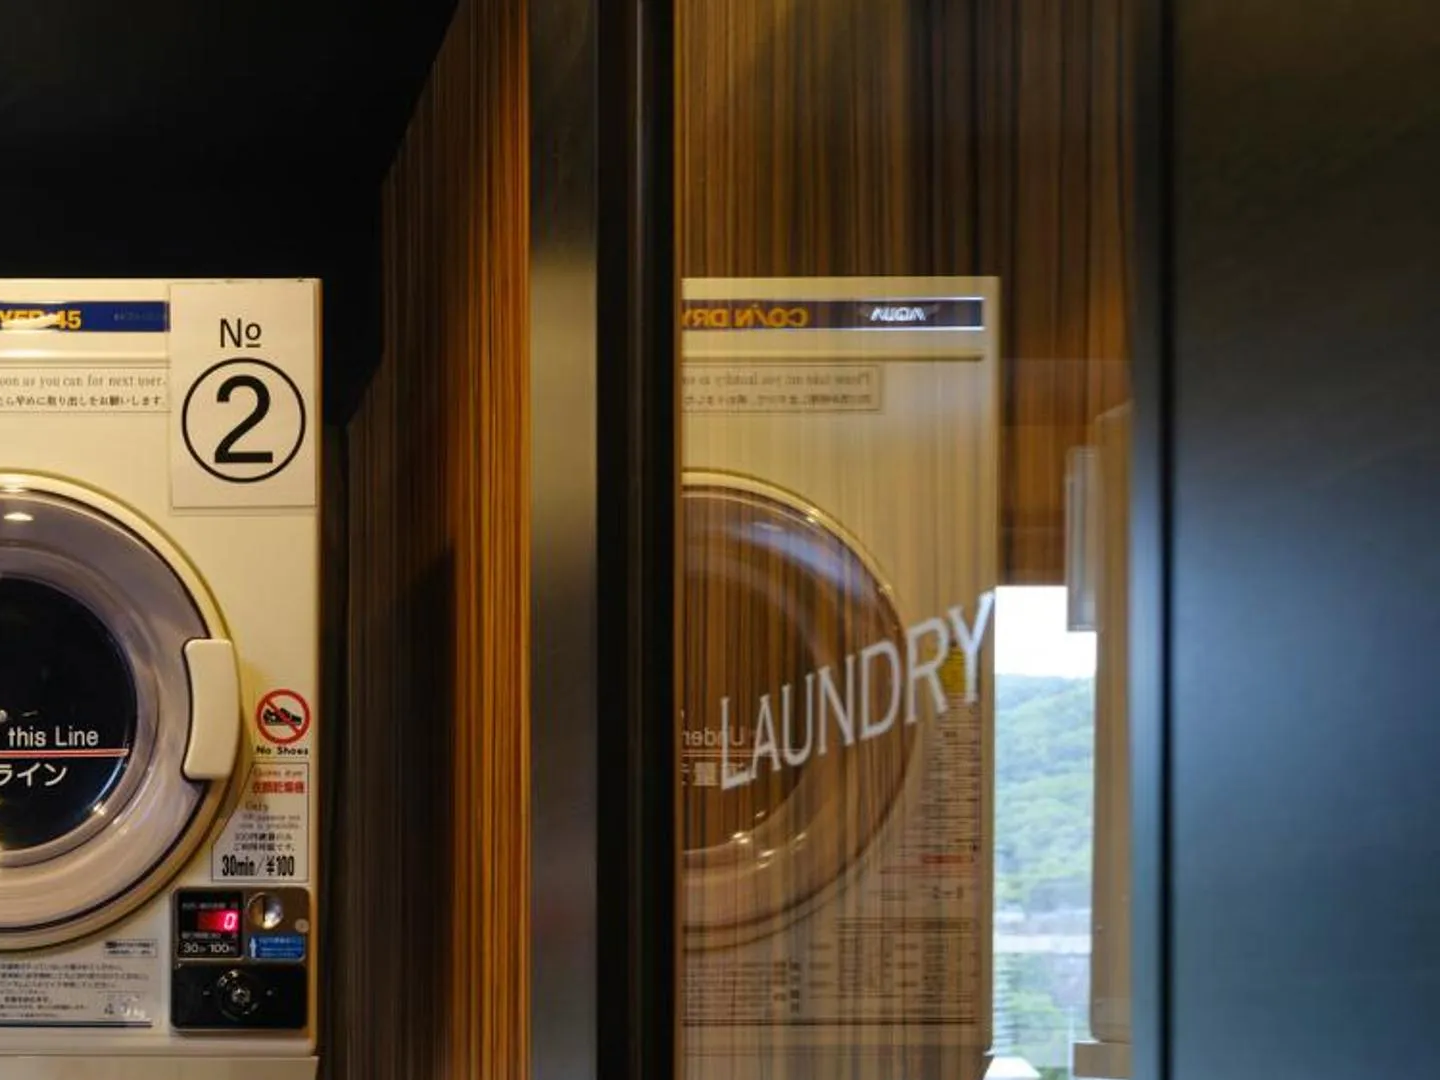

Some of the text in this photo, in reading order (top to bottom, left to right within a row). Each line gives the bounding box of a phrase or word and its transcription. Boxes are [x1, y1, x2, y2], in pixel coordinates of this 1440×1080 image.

[22, 377, 35, 387] as
[40, 377, 60, 390] you
[213, 374, 274, 465] 2
[721, 592, 994, 790] LAUNDRY
[8, 726, 46, 747] this
[55, 725, 99, 747] Line
[256, 745, 308, 755] No Shoes
[224, 912, 238, 931] 0
